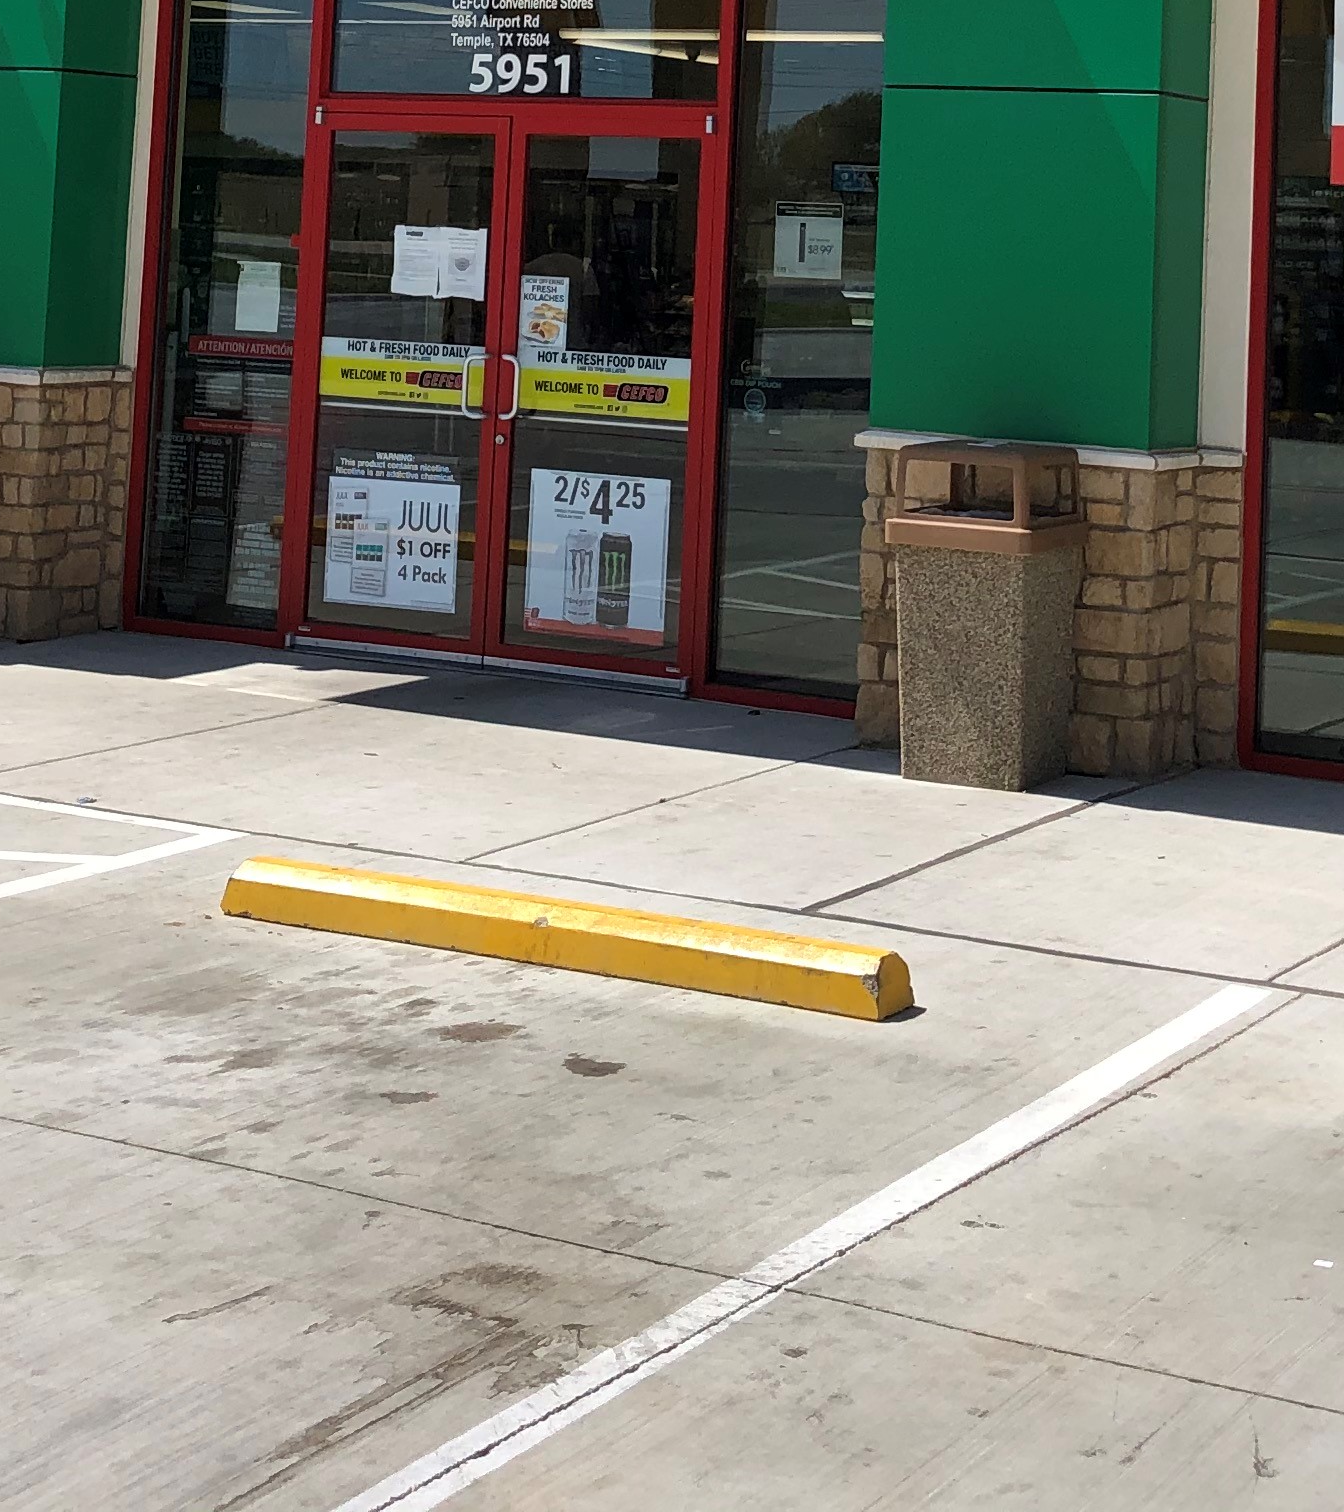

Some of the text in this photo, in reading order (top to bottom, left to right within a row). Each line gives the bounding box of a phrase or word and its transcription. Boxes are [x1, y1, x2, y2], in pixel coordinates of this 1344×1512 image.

[451, 14, 540, 30] 5951 Airport Rd
[451, 32, 550, 49] Temple, TX 76504
[469, 53, 571, 94] 5951
[523, 292, 565, 303] KOLACHES
[531, 285, 558, 293] FRESH
[348, 340, 367, 352] HOT
[370, 341, 376, 352] &
[379, 341, 411, 355] FRESH
[413, 343, 440, 356] FOOD
[442, 345, 471, 358] DAILY
[537, 351, 668, 370] HOT & FRESH FOOD DAILY
[341, 368, 387, 382] WELCOME
[389, 371, 402, 383] TO
[535, 380, 665, 402] WELCOME TO CEFCO
[340, 457, 356, 466] This
[357, 460, 386, 469] product
[376, 452, 416, 462] WARNING:
[336, 466, 365, 475] Nicotine
[367, 468, 374, 476] is
[397, 500, 452, 534] JUUL
[397, 537, 451, 560] $1 OFF
[397, 565, 447, 584] 4 Pack
